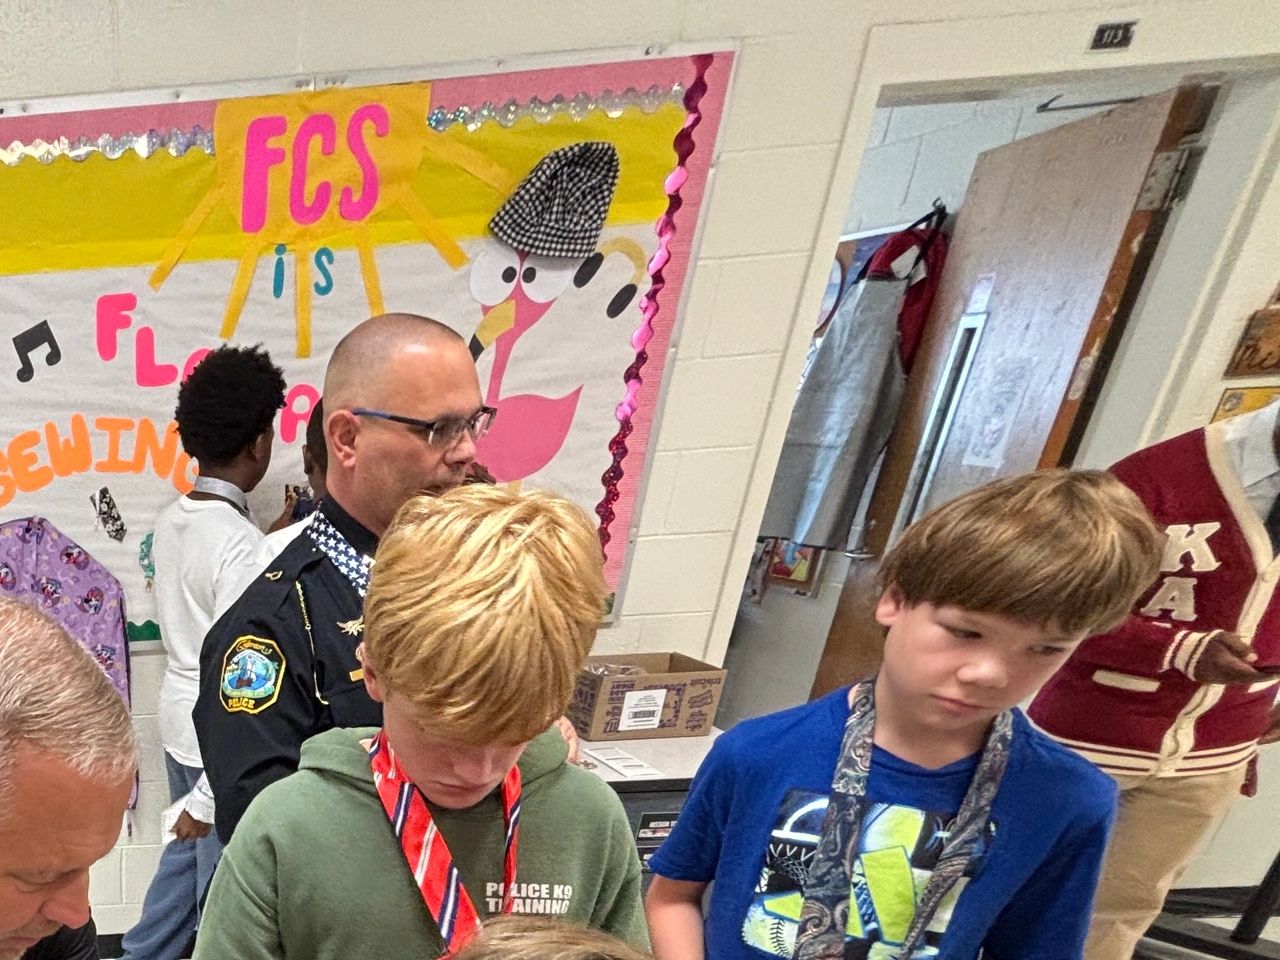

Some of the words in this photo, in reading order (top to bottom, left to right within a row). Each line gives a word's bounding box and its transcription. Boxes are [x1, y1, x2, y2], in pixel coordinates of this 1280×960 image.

[241, 102, 390, 234] FCS
[272, 243, 335, 299] is
[1160, 522, 1222, 572] K
[1140, 576, 1198, 622] A
[228, 697, 256, 709] POLICE
[486, 897, 570, 914] TAINING
[553, 884, 573, 899] K9
